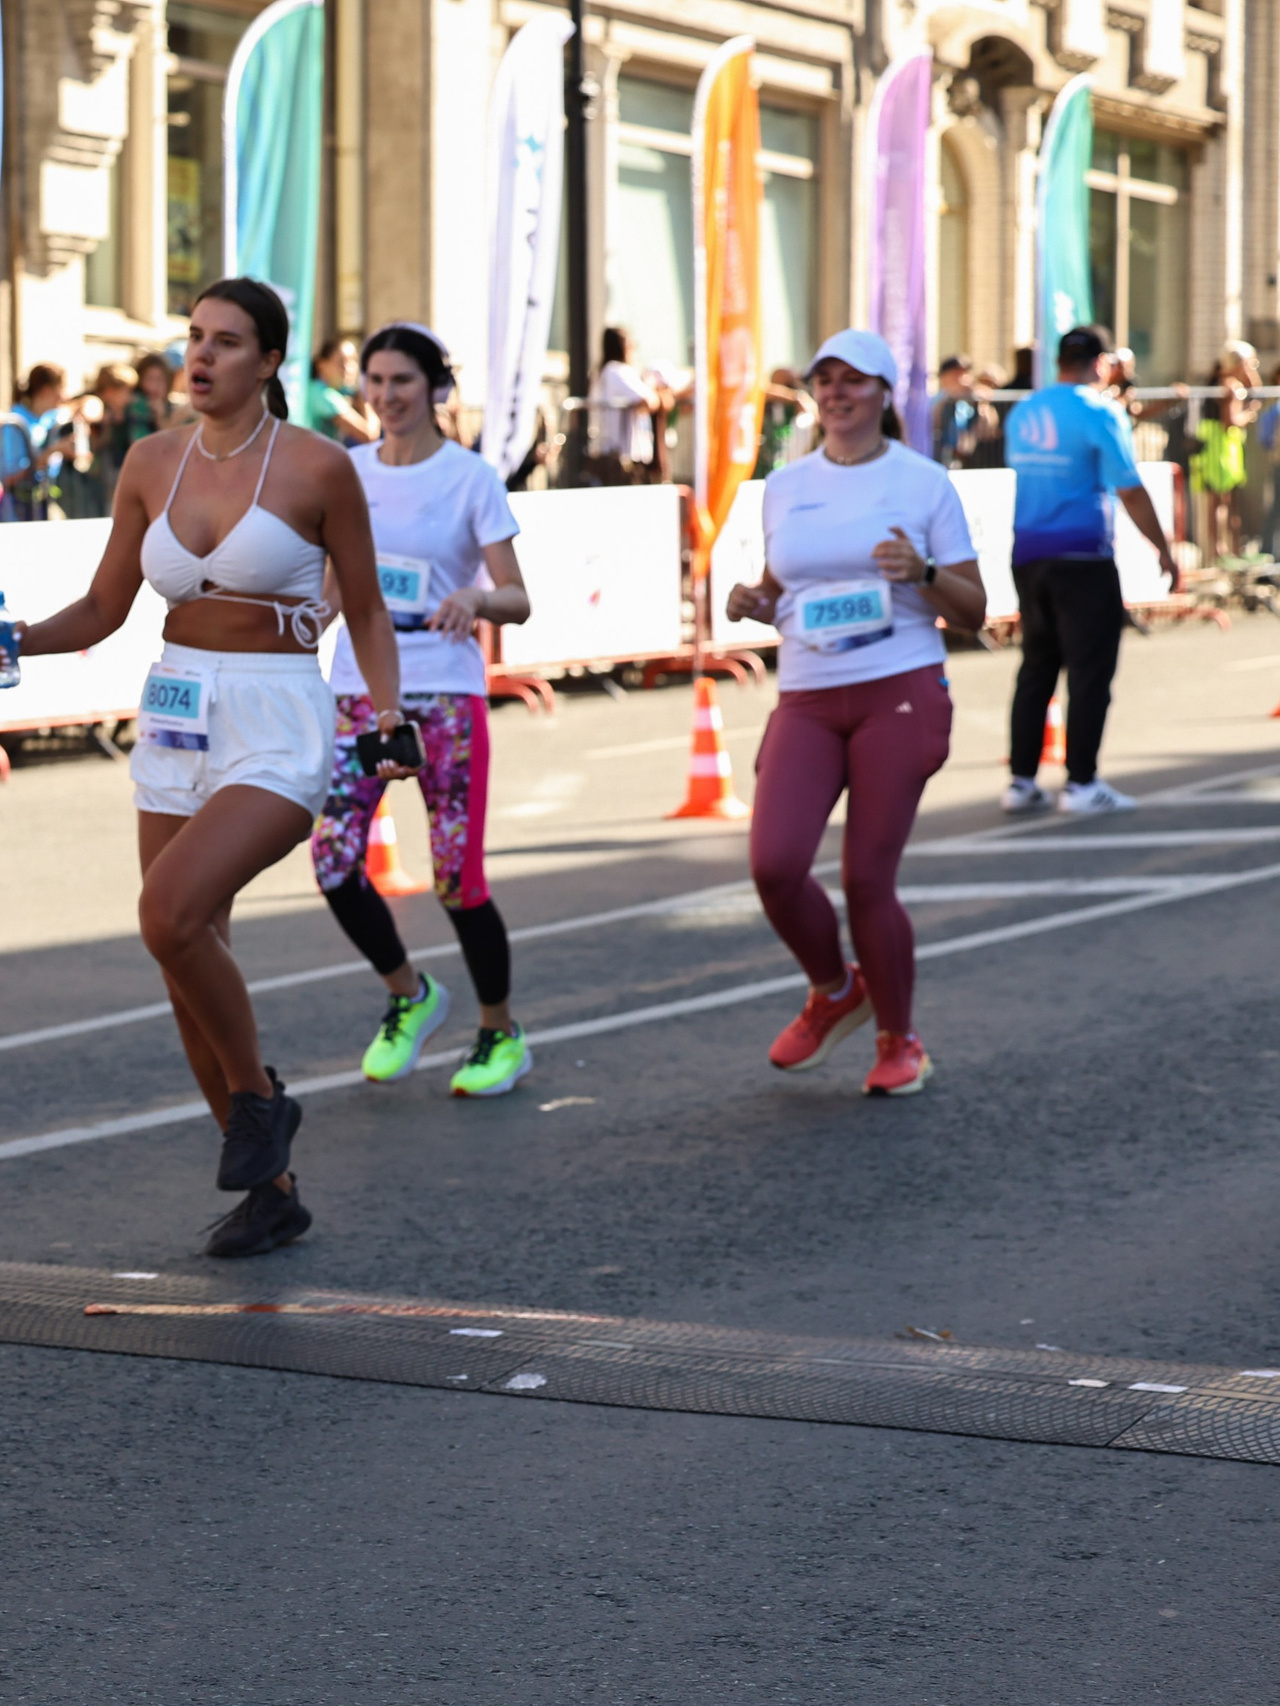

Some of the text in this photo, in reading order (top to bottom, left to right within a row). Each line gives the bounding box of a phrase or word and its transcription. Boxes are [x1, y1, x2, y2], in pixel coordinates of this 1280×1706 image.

[381, 572, 410, 596] 93
[812, 597, 873, 624] 7598
[147, 683, 192, 711] 8074
